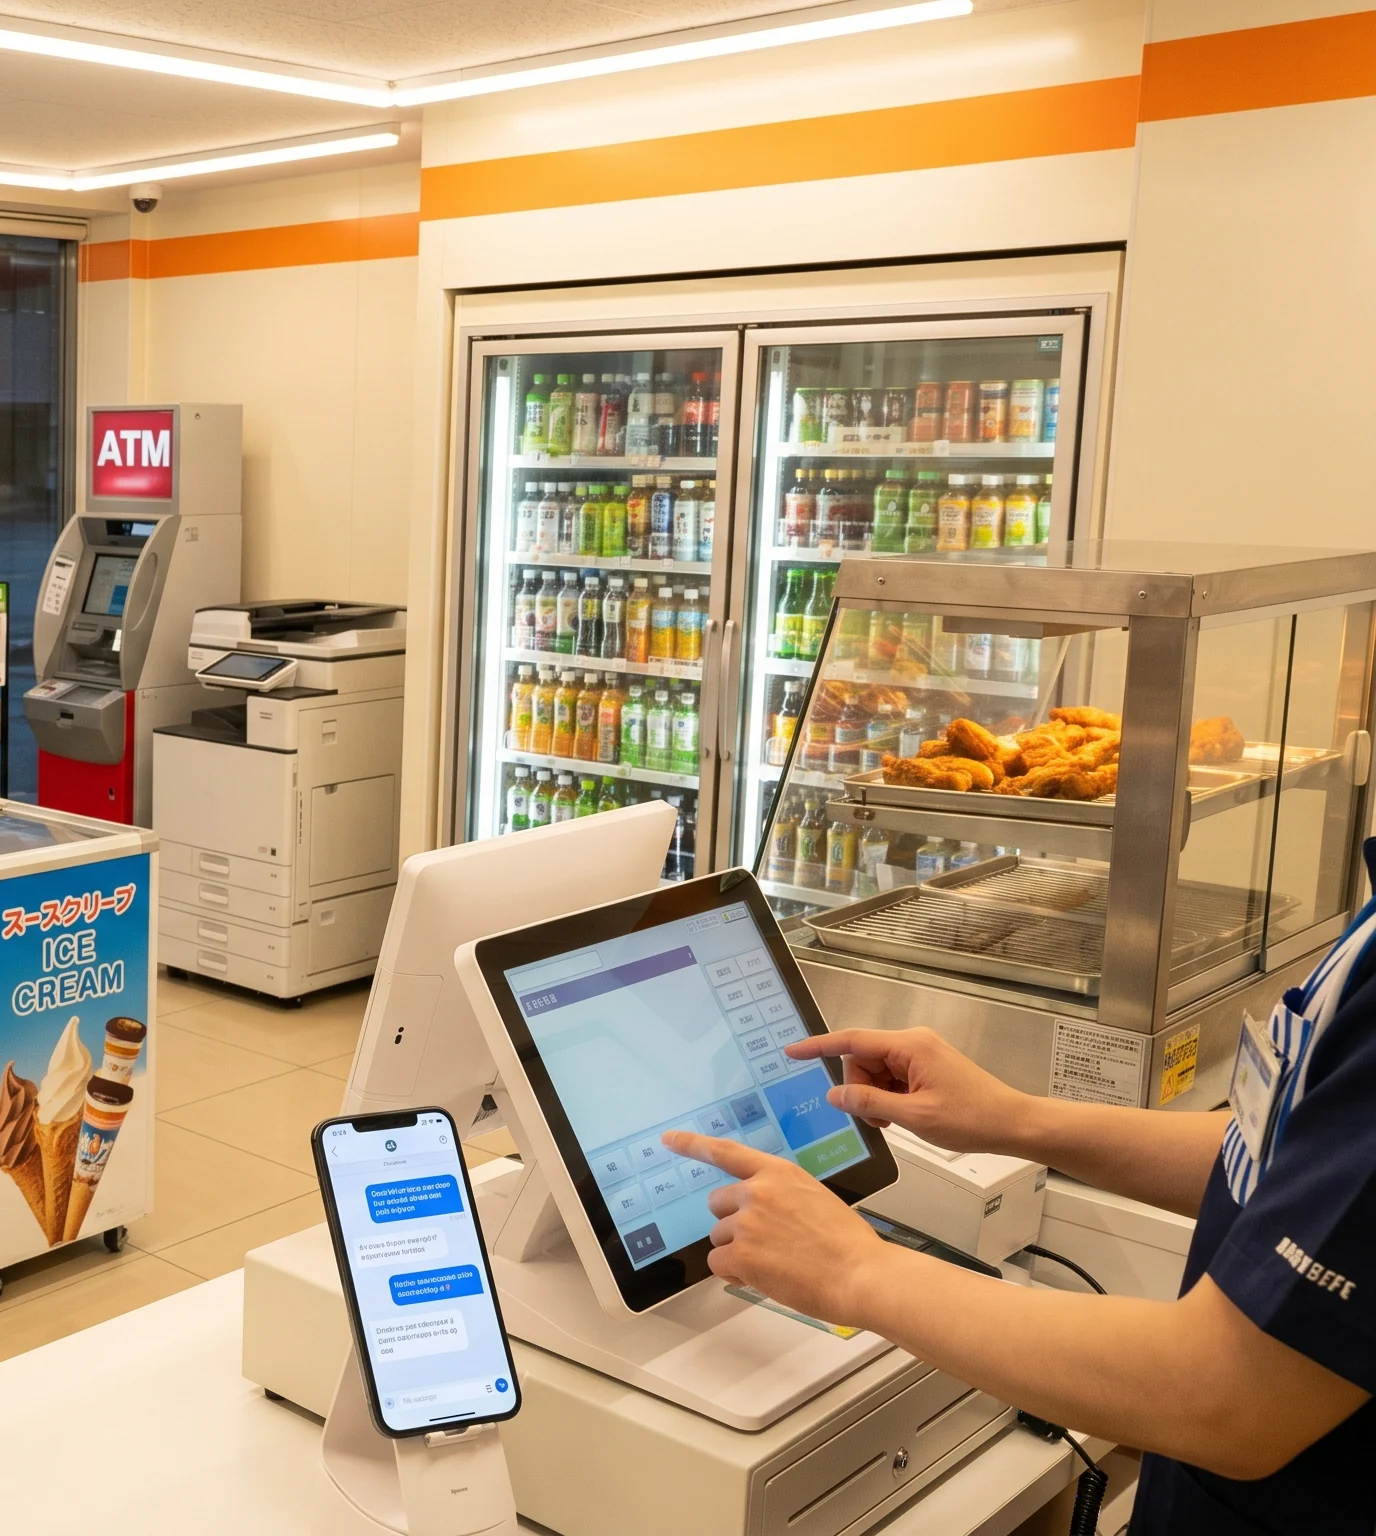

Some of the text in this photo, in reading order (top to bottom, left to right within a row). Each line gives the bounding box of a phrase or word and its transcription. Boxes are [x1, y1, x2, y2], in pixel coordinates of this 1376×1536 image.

[96, 429, 170, 467] ATM
[42, 928, 97, 973] ICE
[12, 959, 125, 1017] CREAM
